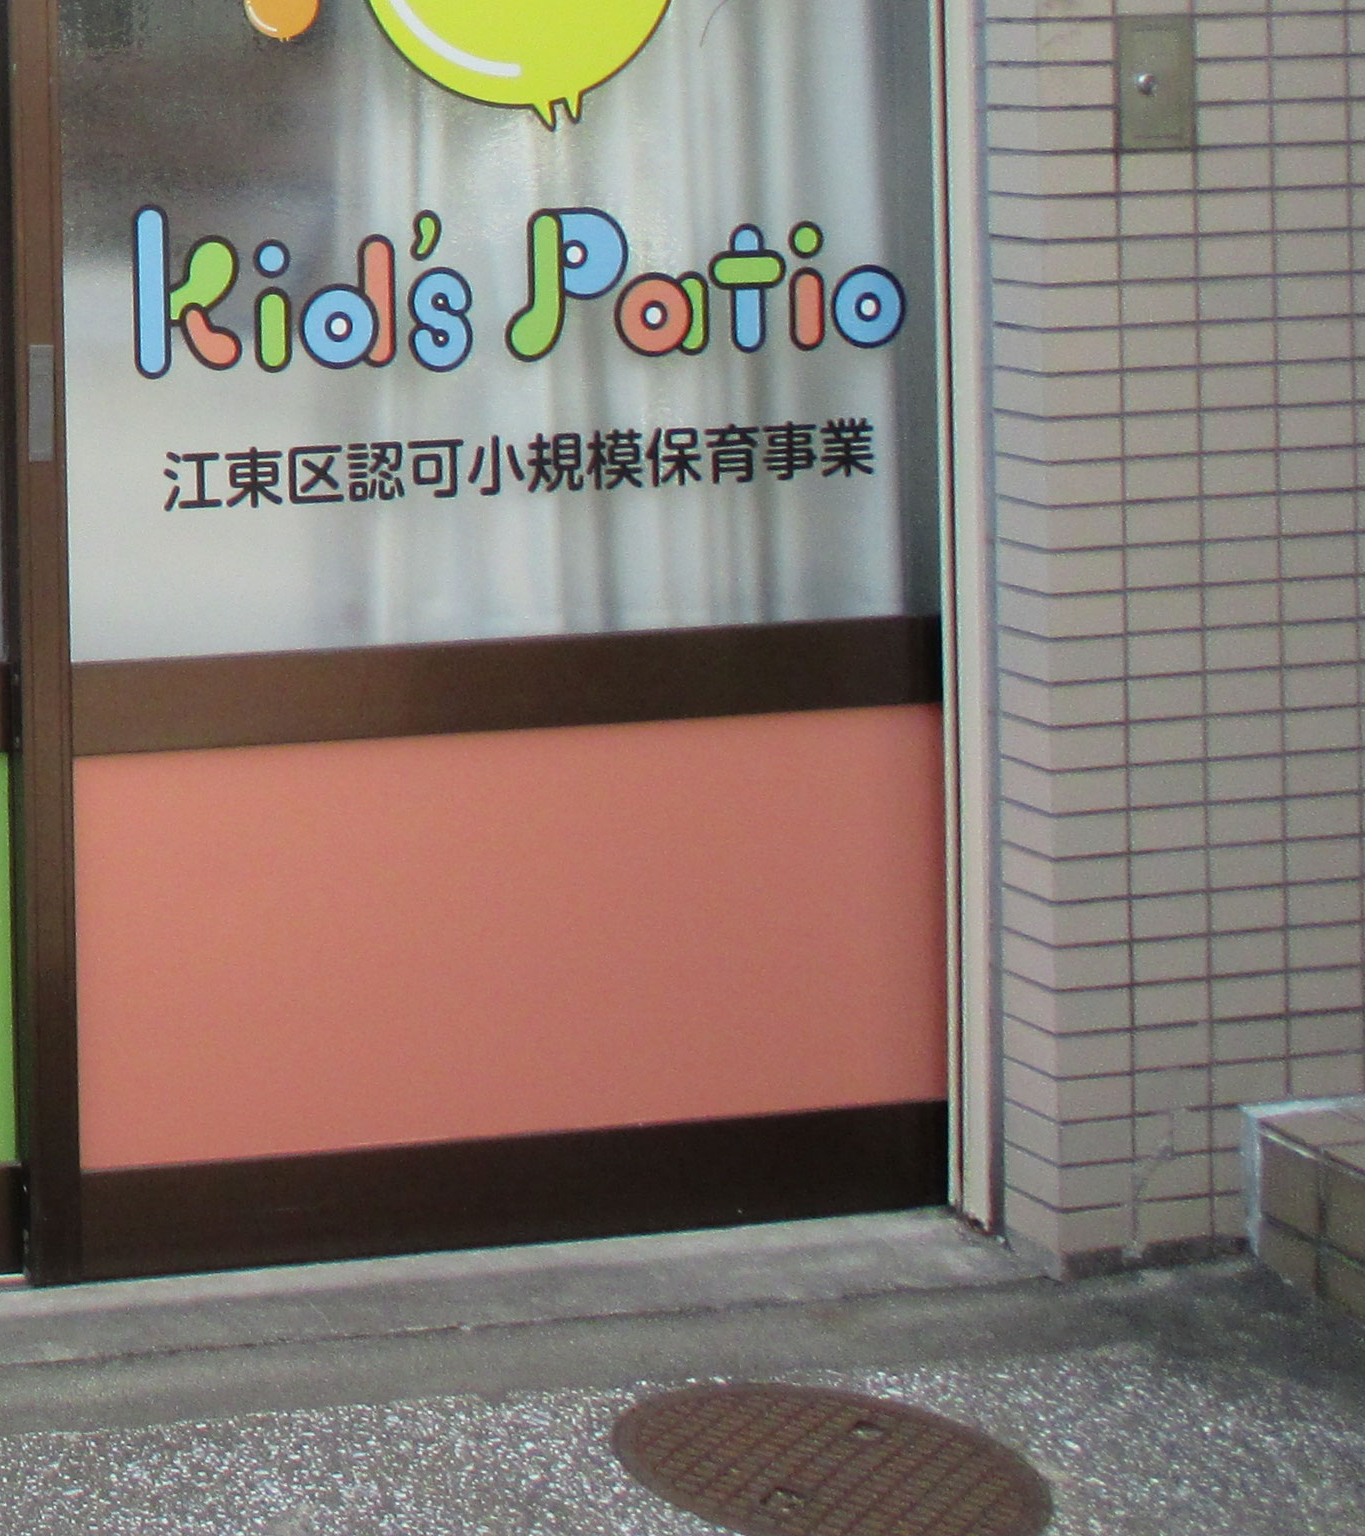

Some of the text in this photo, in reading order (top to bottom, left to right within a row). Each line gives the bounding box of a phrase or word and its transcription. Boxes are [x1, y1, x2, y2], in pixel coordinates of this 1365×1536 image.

[505, 207, 907, 362] Patio
[163, 418, 876, 513] 江東区認可小規模保育事業
